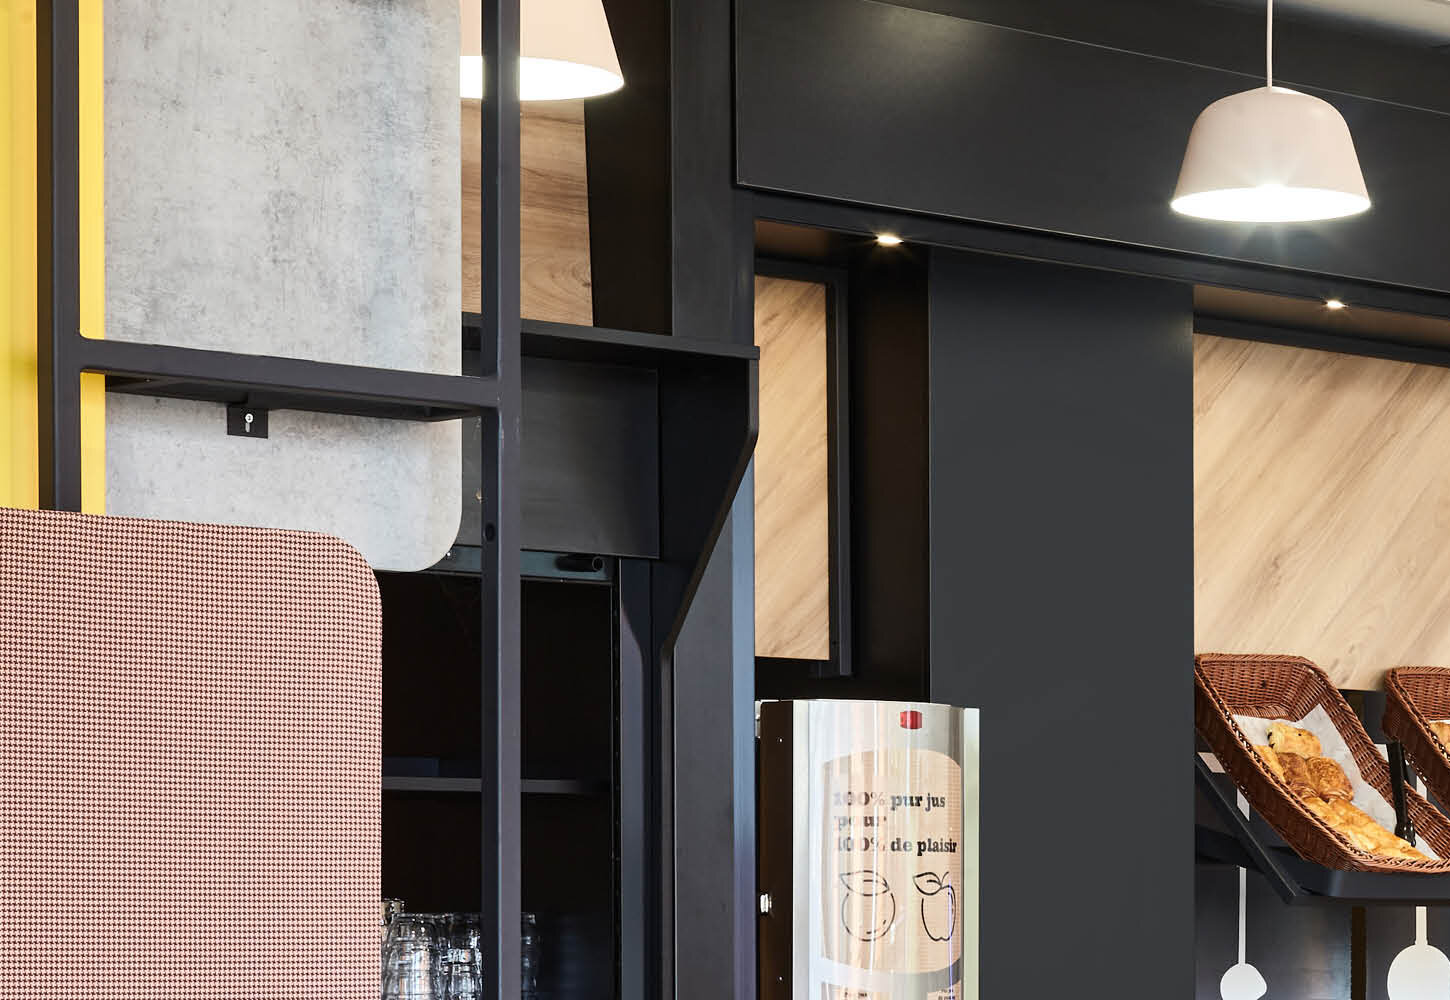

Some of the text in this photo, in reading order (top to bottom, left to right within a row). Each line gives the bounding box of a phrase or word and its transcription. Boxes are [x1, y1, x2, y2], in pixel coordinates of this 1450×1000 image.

[890, 794, 923, 811] pur
[925, 792, 946, 812] jus
[890, 837, 913, 852] de
[917, 837, 957, 856] plaisir
